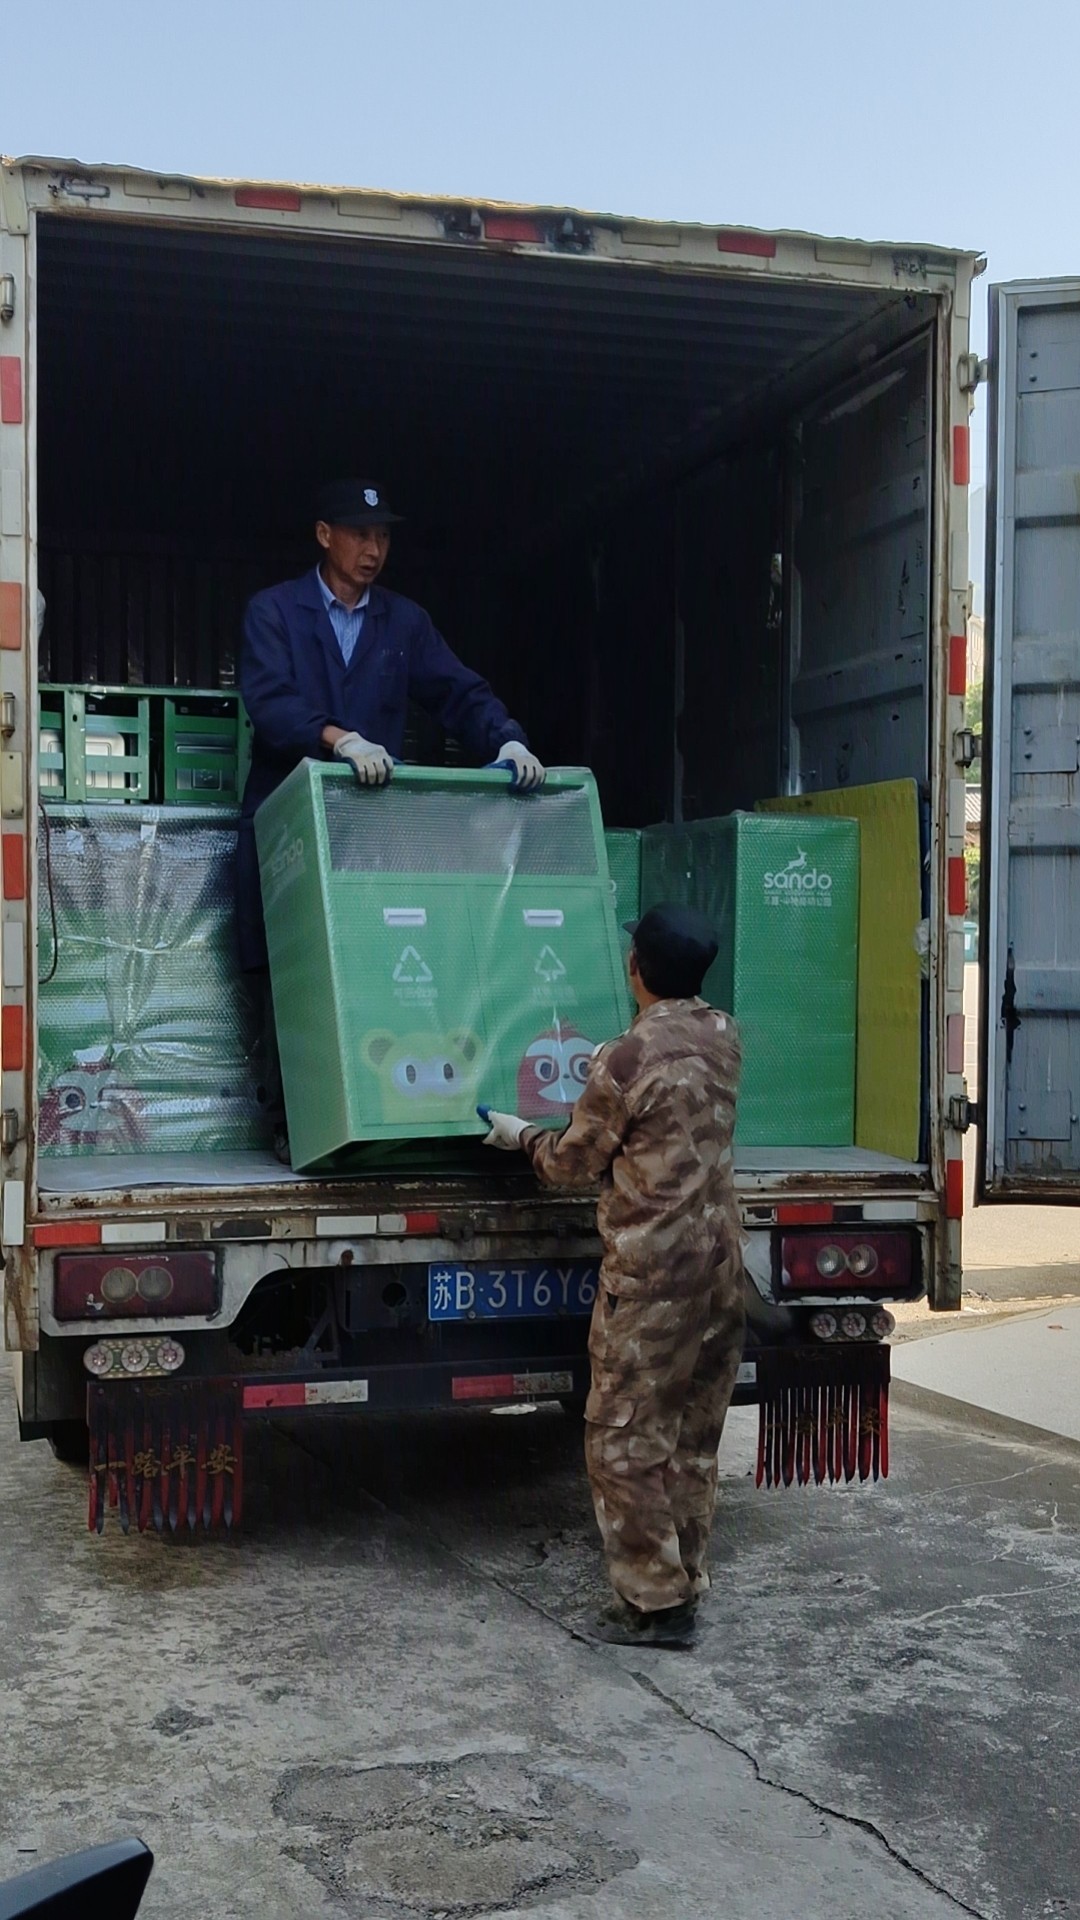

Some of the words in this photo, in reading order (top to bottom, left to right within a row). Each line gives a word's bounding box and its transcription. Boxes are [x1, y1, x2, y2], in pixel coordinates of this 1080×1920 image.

[764, 868, 833, 890] sando
[94, 1443, 238, 1479] 一路平安
